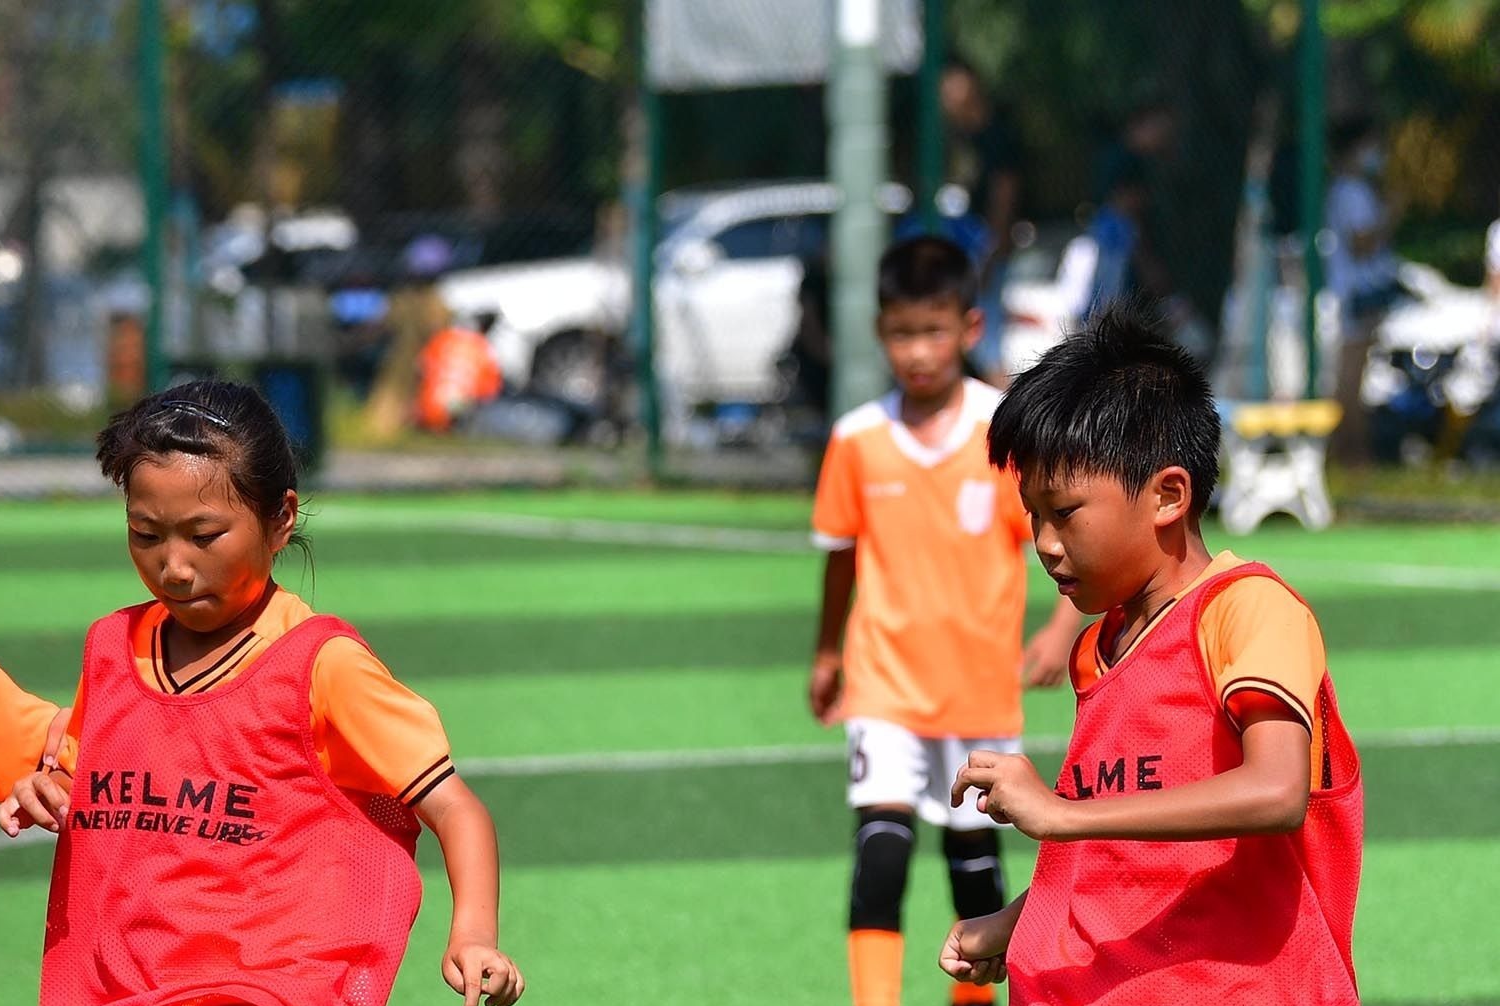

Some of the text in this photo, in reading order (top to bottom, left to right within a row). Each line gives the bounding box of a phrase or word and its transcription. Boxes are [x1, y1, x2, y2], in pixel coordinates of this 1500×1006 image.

[90, 770, 258, 820] KELME
[1054, 755, 1163, 800] LME
[71, 809, 132, 831] NEVER
[134, 810, 194, 836] GIVE
